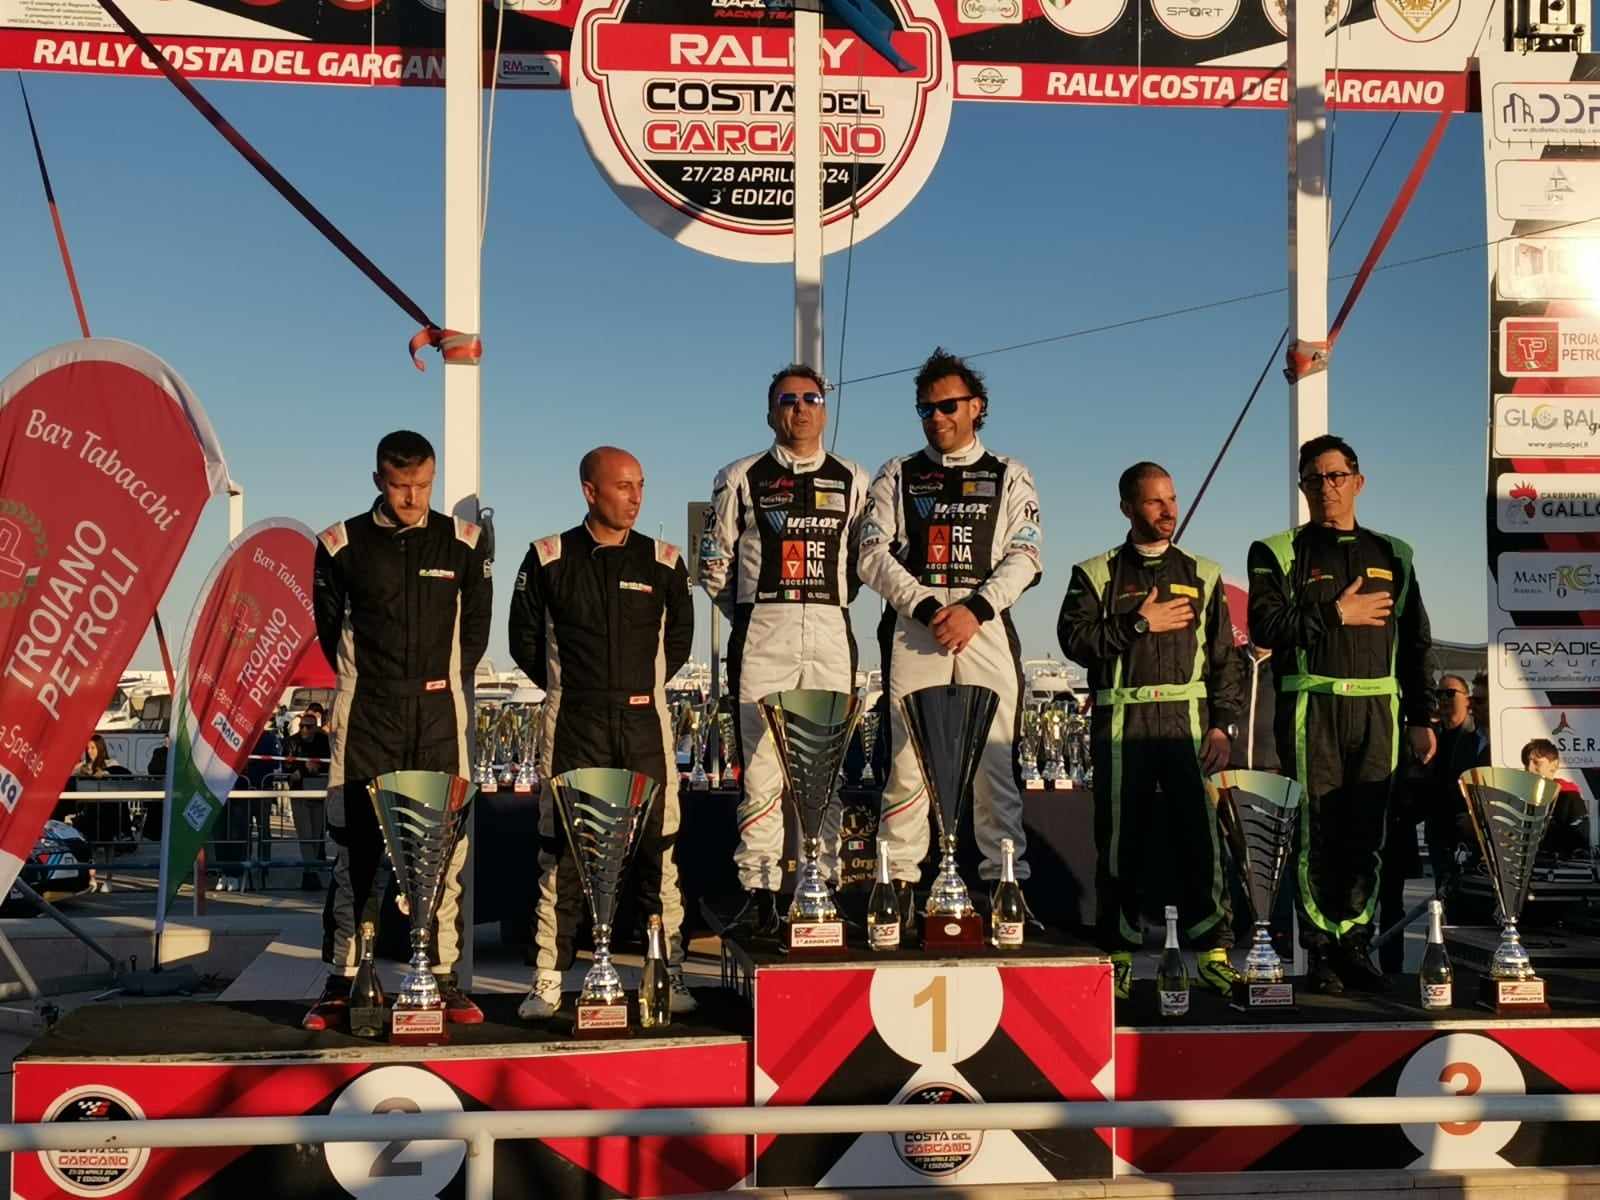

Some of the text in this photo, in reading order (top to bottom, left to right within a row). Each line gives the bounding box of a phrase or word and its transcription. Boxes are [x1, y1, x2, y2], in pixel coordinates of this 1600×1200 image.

[33, 39, 137, 68] RALLY
[141, 44, 245, 73] COSTA
[250, 48, 311, 76] DEL
[670, 33, 855, 69] RALY
[646, 82, 796, 112] COSTA
[1047, 71, 1138, 98] RALLY
[1142, 74, 1236, 100] COSTA
[1325, 79, 1445, 105] ARGANO
[681, 166, 735, 183] 27/28
[25, 409, 182, 532] Bar Tabacchi
[787, 516, 842, 529] VELOX
[934, 503, 991, 514] VELOX
[253, 547, 275, 571] Bar
[4, 520, 107, 689] TROIANO
[37, 547, 139, 721] PETROLI
[236, 608, 287, 689] TROIANO
[248, 623, 302, 708] PETROLI
[913, 975, 947, 1053] 1
[1438, 1062, 1482, 1136] 3
[368, 1097, 423, 1177] 2
[904, 1142, 972, 1154] GARGANO
[58, 1155, 129, 1166] GARGANO
